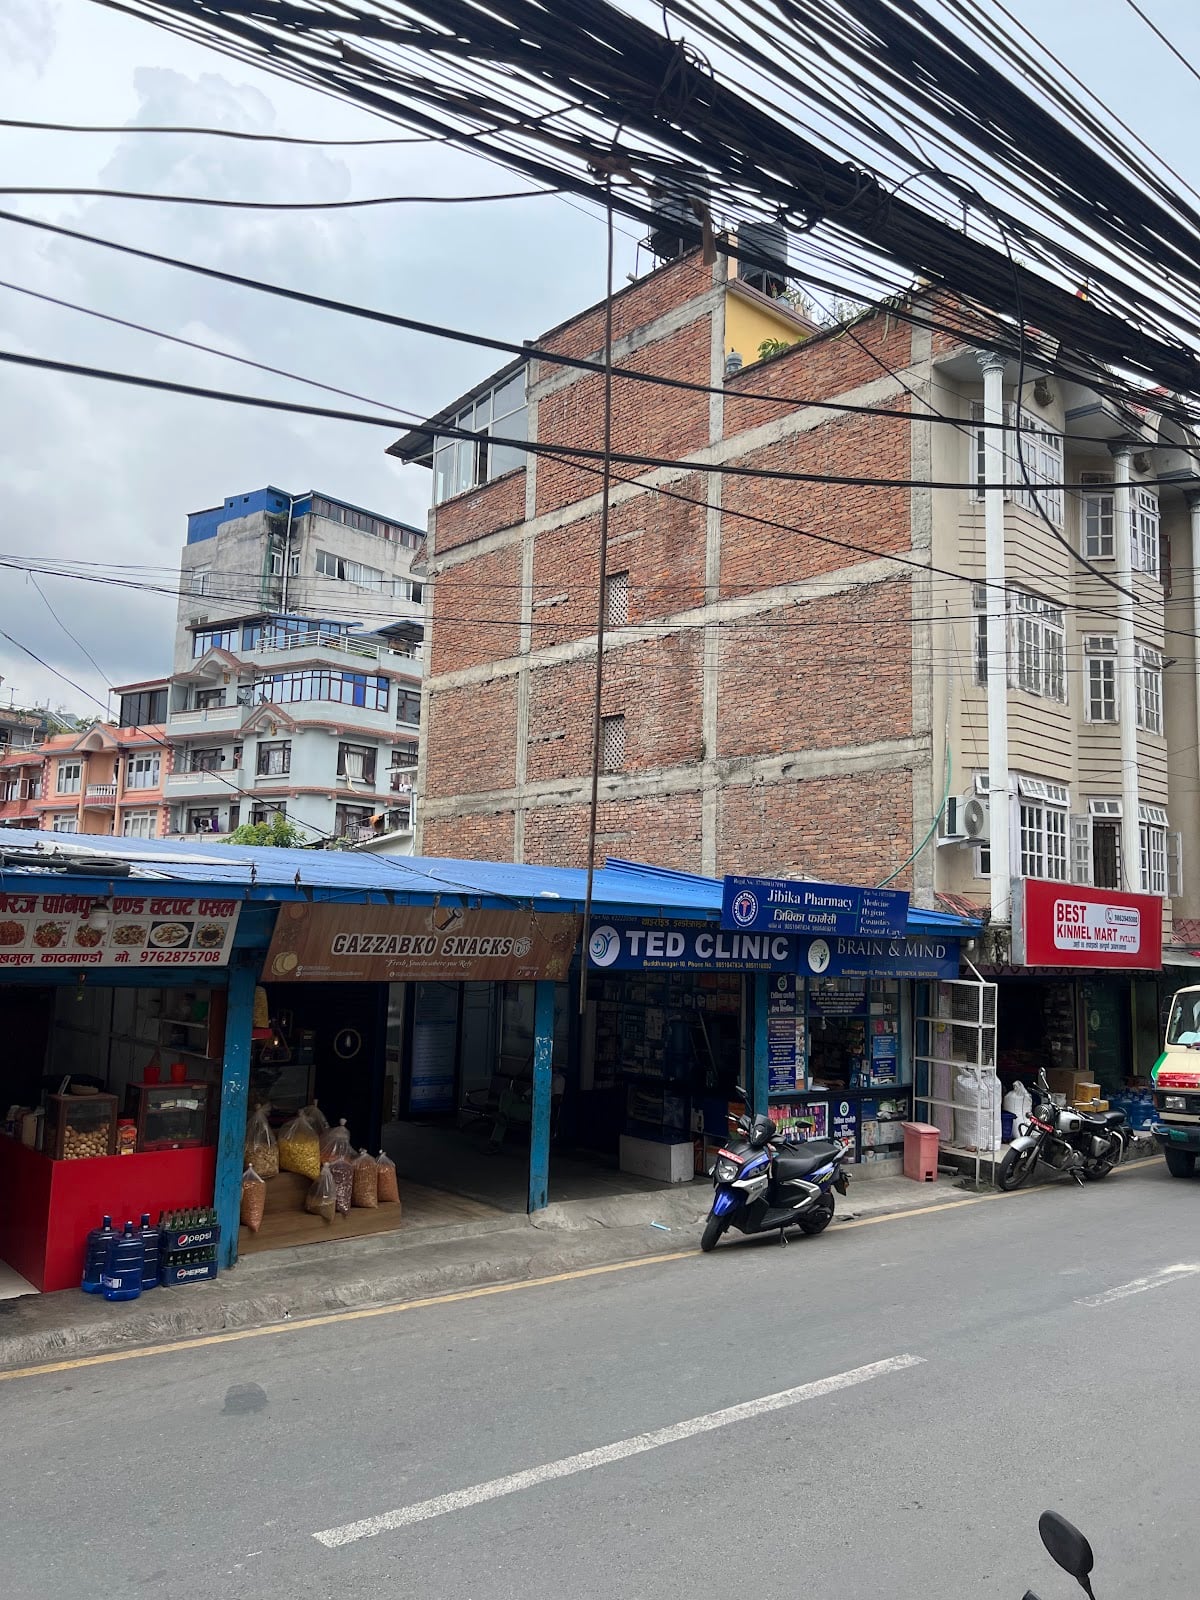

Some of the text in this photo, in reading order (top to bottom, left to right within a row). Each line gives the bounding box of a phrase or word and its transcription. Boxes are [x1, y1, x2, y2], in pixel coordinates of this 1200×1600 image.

[767, 889, 800, 904] Jibika
[804, 892, 853, 911] Pharmacy
[863, 898, 890, 908] Medicine
[861, 907, 887, 917] Hygiene
[1056, 903, 1087, 924] BEST
[860, 926, 885, 935] Personal
[1056, 924, 1092, 940] KINMEL
[1094, 927, 1118, 941] MART
[331, 932, 515, 958] GAZZABKO SNACKS
[626, 930, 789, 960] TED CLINIC
[837, 937, 946, 959] BRAIN & MIND
[140, 951, 220, 963] 9762875708
[188, 1231, 212, 1244] pepsi
